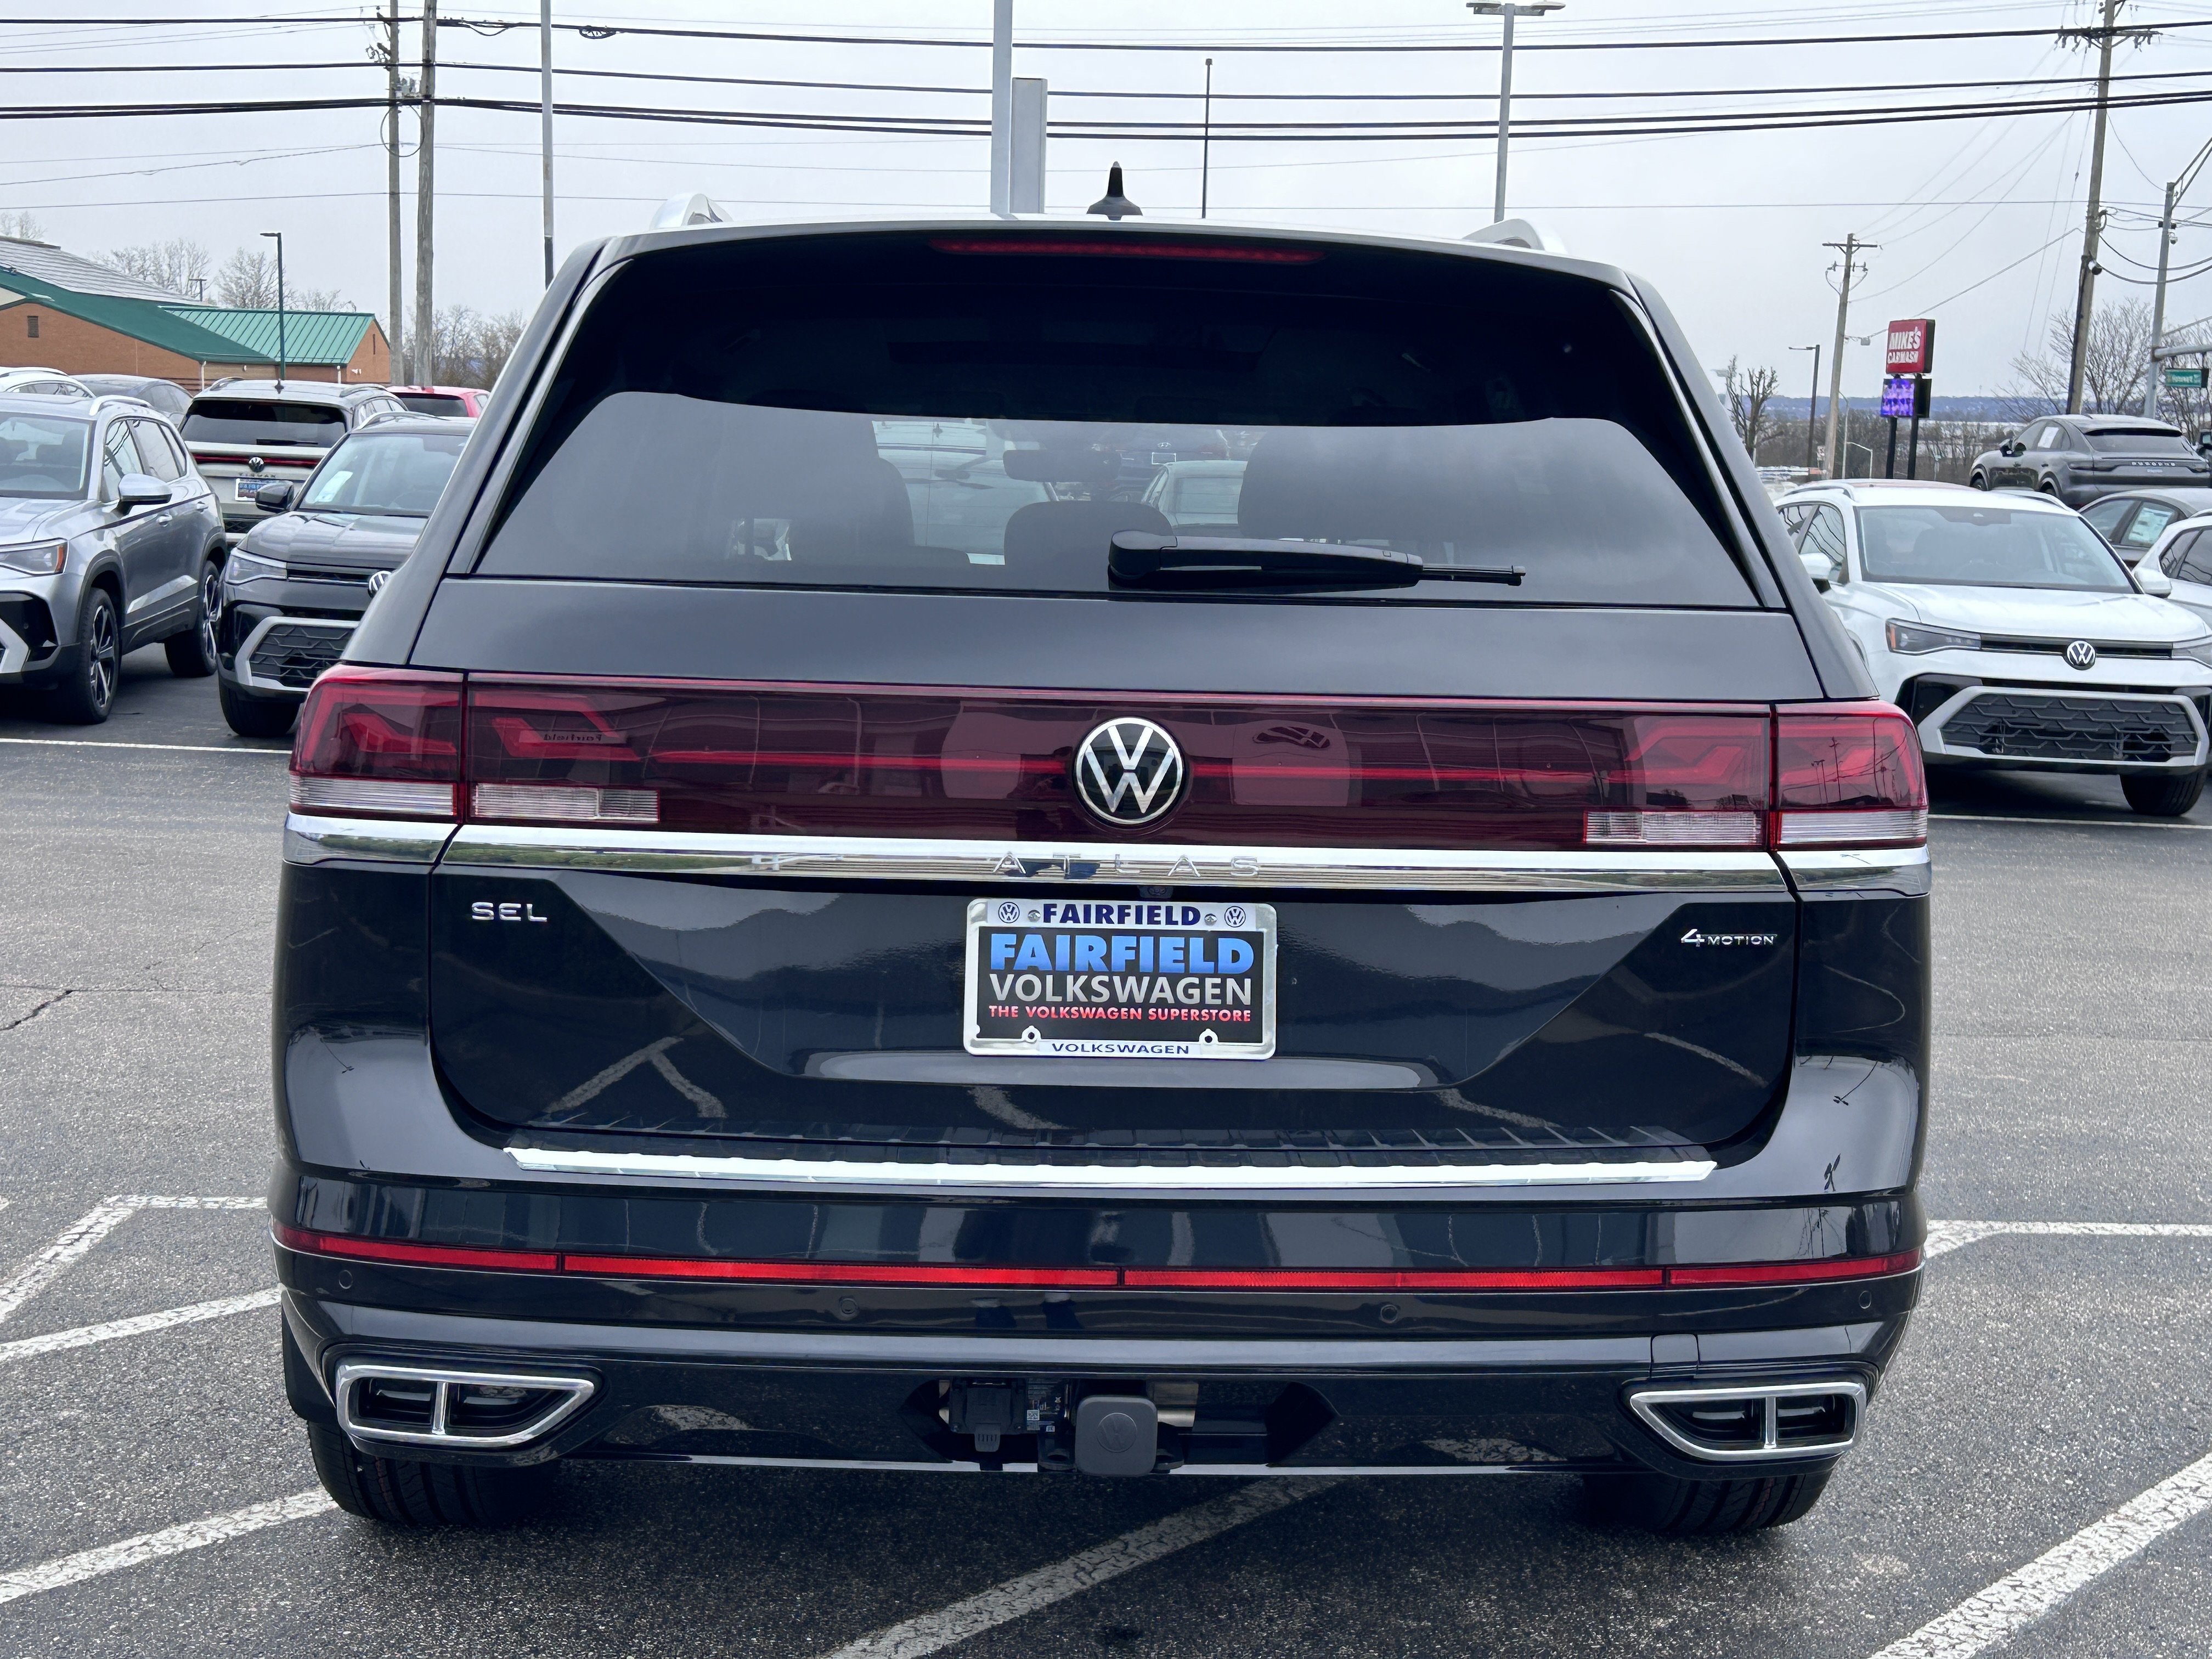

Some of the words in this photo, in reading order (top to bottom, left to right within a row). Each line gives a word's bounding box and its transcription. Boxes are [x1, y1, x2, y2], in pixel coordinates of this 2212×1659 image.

[1888, 326, 1921, 350] MIKE'S
[1078, 720, 1181, 821] VW
[992, 851, 1260, 877] ATLAS
[471, 901, 548, 922] SEL
[1043, 903, 1201, 926] FAIRFIELD
[990, 933, 1255, 974] FAIRFIELD
[989, 973, 1251, 1006] VOLKSWAGEN
[989, 1005, 1019, 1018] THE
[1025, 1006, 1142, 1020] VOLKSWAGEN
[1148, 1008, 1251, 1022] SUPERSTORE
[1052, 1043, 1189, 1054] VOLKSWAGEN
